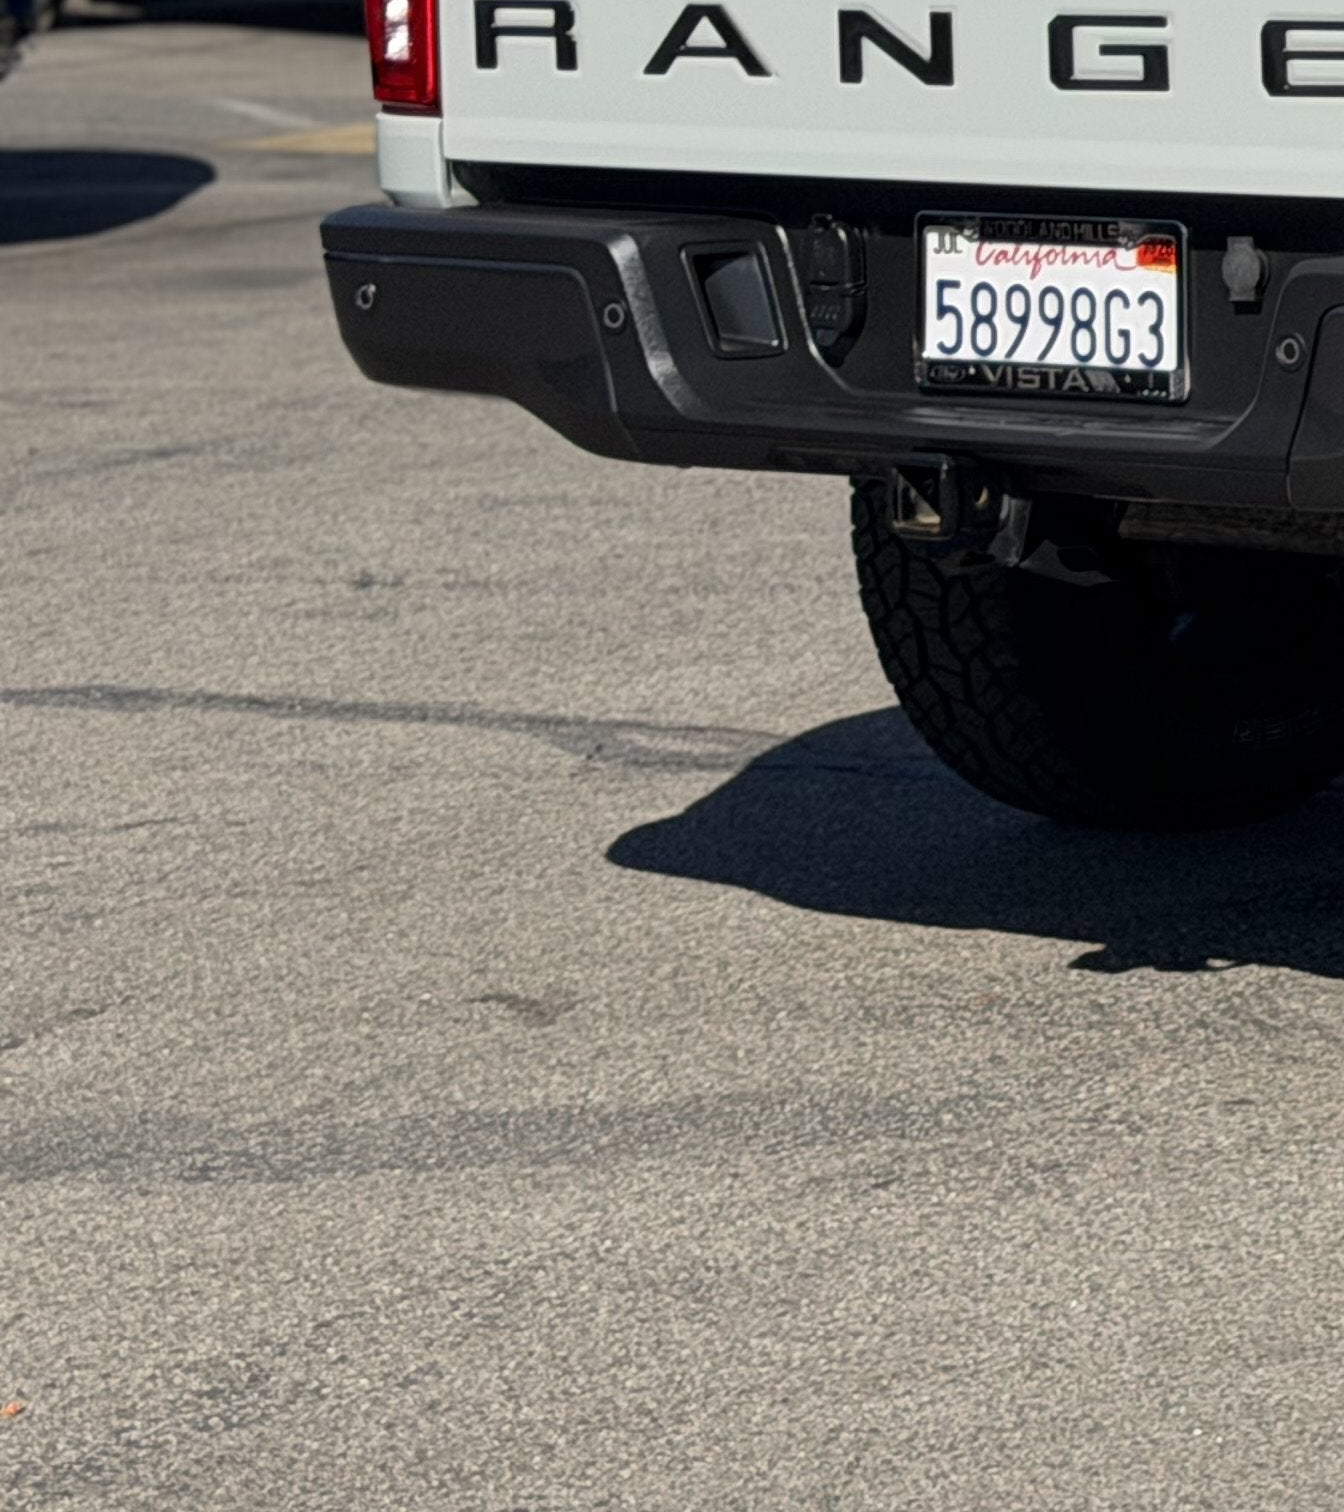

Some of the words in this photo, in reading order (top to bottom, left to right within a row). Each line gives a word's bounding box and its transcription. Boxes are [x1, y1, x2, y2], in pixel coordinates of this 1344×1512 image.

[975, 239, 1138, 280] California
[936, 278, 1164, 367] 58998G3
[980, 364, 1090, 393] VISTA
